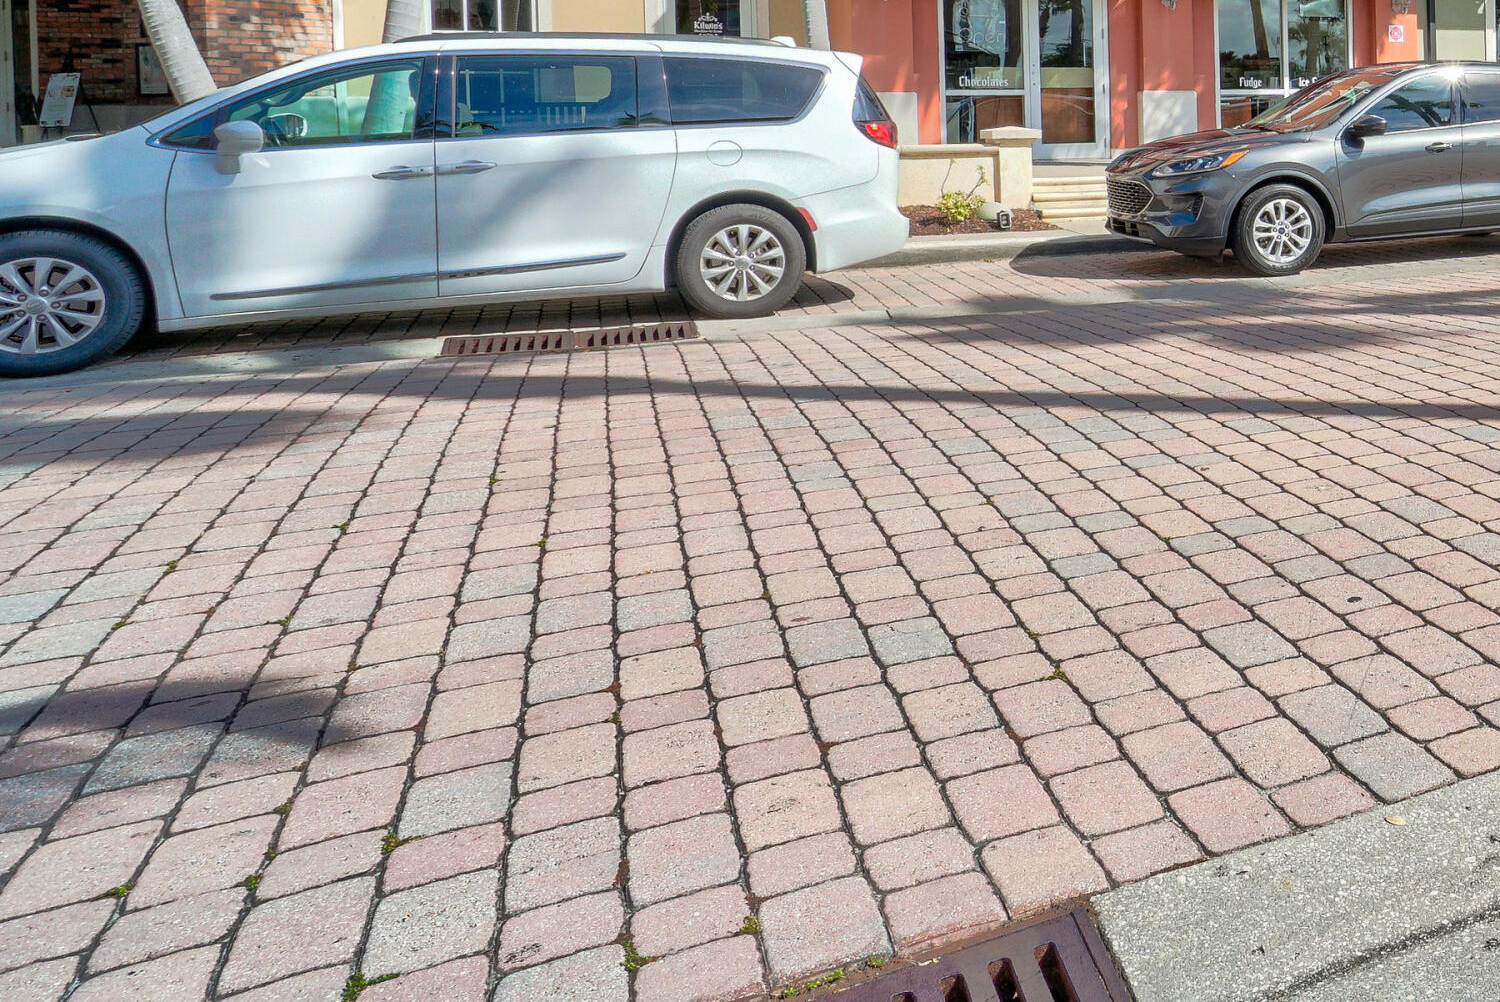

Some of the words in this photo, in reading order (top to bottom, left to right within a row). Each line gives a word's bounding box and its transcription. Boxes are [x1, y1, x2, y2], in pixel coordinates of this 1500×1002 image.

[958, 76, 1009, 87] Chocolates
[1240, 77, 1262, 87] Fudge
[1299, 76, 1310, 87] Ice
